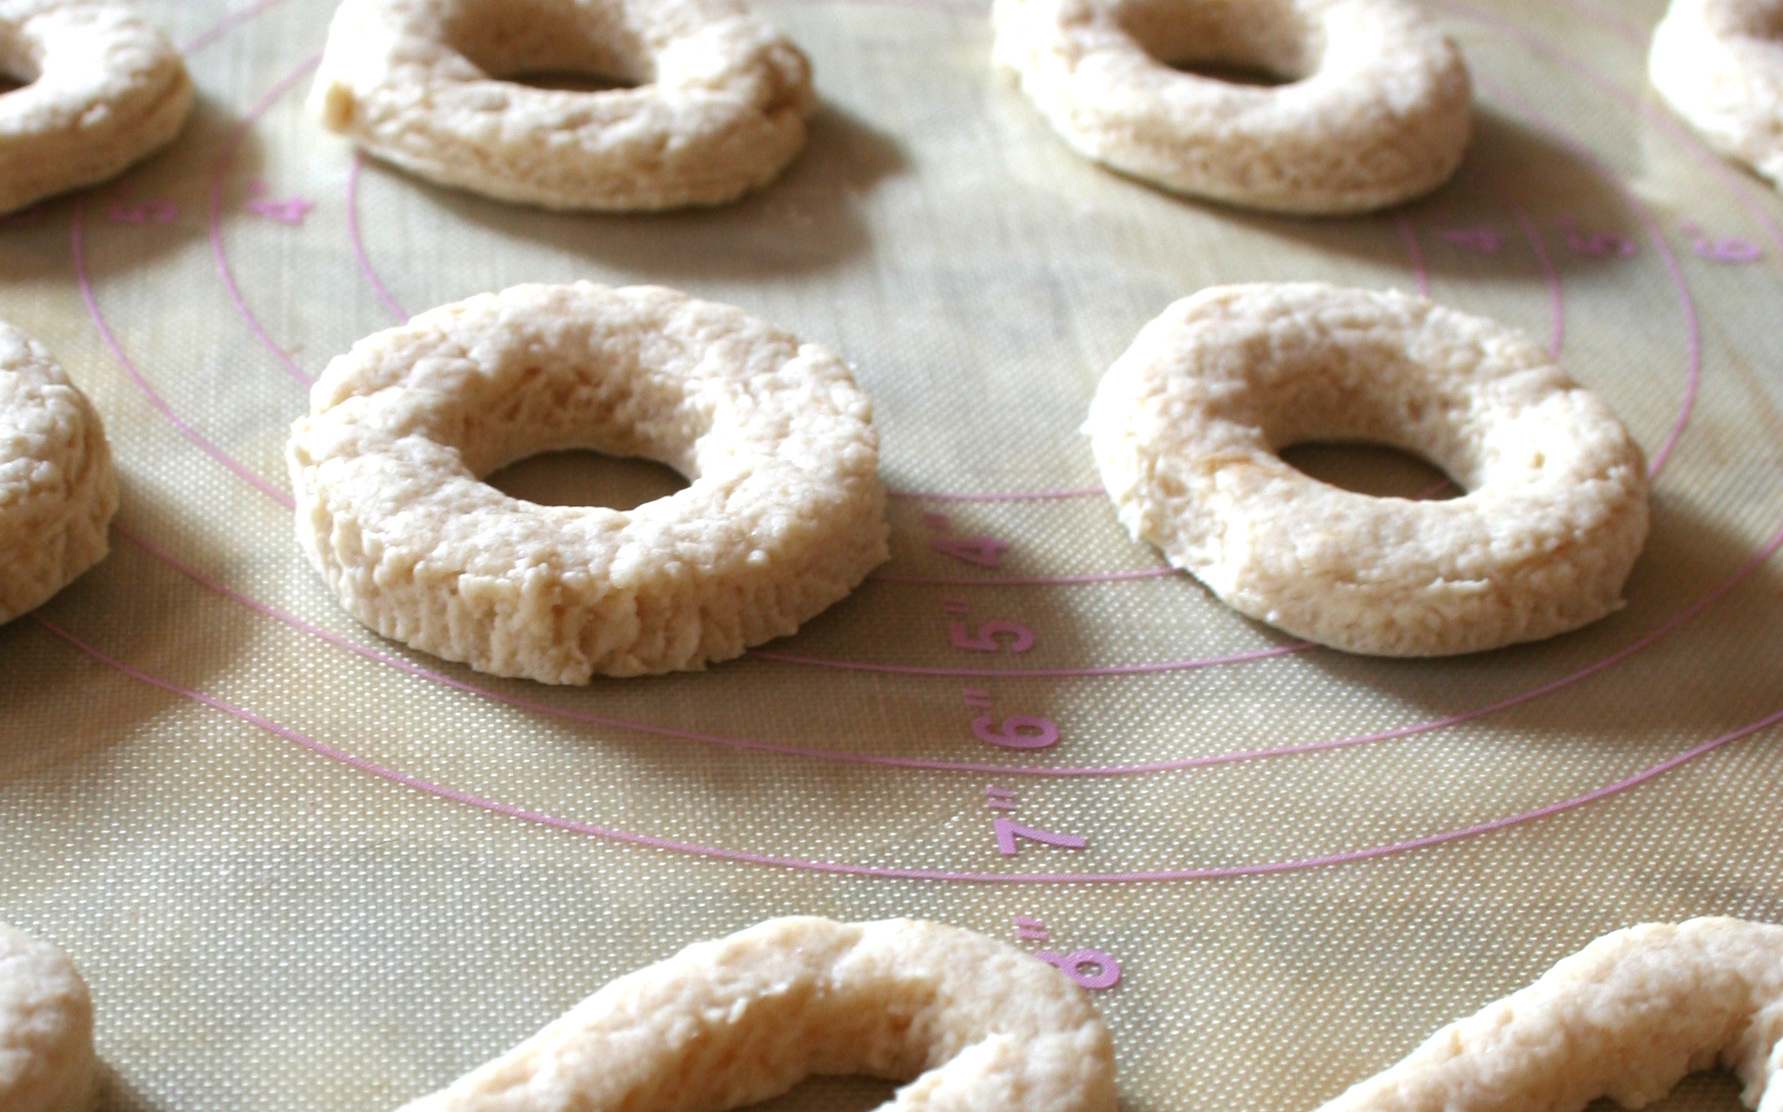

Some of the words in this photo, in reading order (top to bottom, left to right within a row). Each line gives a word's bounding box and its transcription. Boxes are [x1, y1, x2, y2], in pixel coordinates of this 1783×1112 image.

[940, 596, 1035, 654] 5"
[961, 688, 1060, 748] 6"
[985, 785, 1087, 857] 7"
